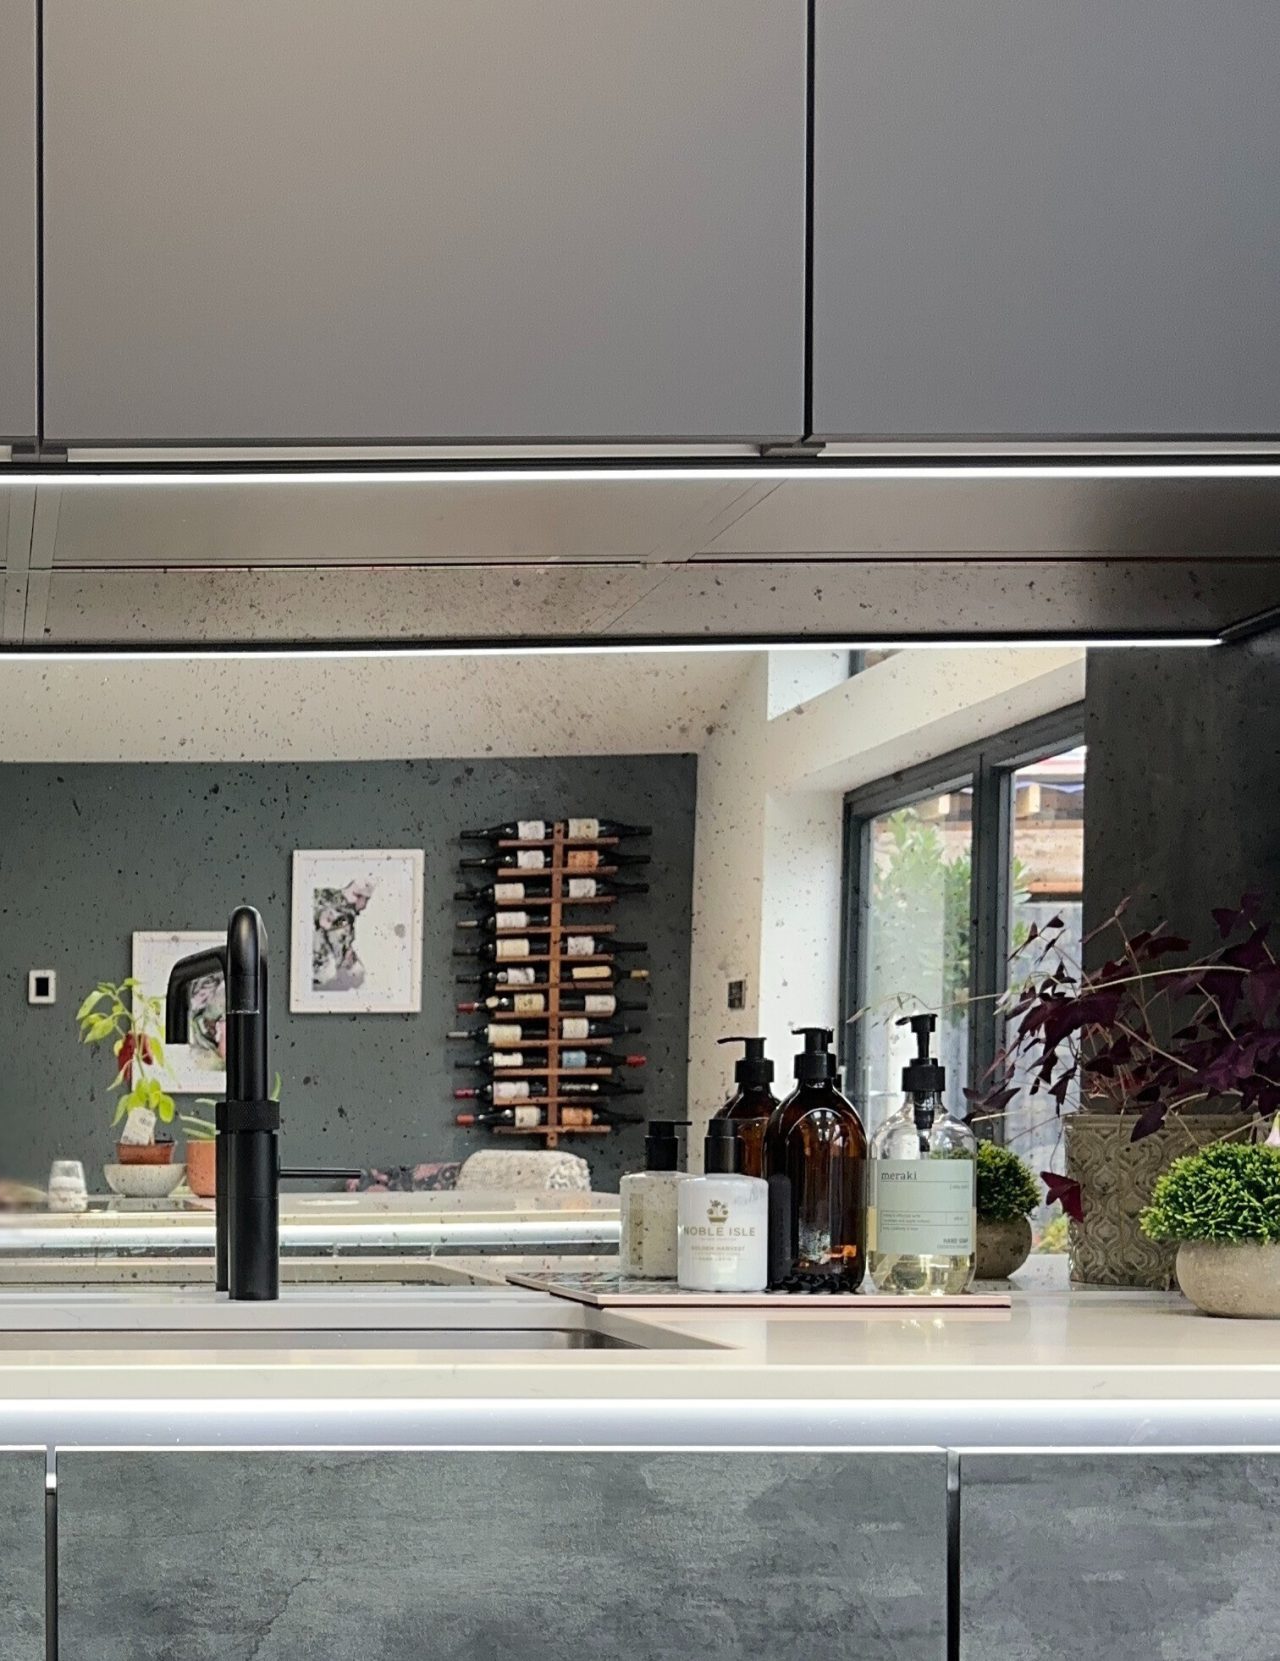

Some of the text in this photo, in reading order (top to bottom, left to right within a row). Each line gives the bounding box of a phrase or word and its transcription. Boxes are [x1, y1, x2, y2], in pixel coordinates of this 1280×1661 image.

[881, 1171, 917, 1180] meraki
[683, 1226, 756, 1237] NOBLE ISLE
